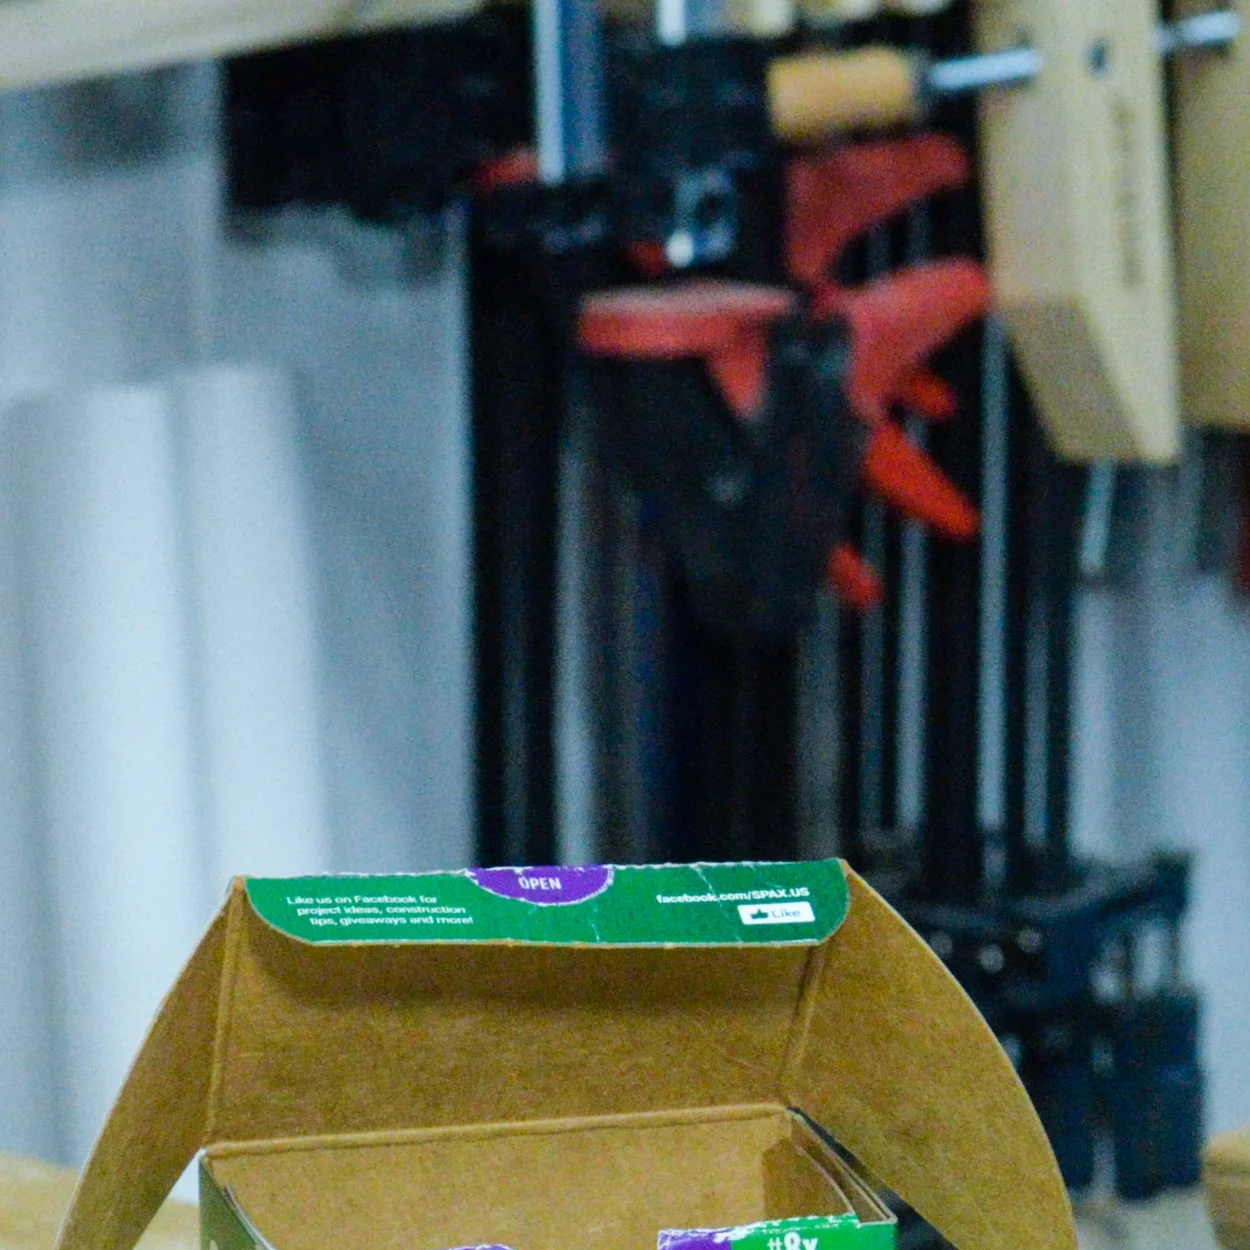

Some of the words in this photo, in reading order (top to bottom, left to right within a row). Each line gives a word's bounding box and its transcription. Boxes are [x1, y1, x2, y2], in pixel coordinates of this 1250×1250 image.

[518, 876, 562, 891] OPEN
[287, 896, 314, 905] Like
[318, 897, 332, 905] us
[354, 895, 417, 904] Facebook
[419, 895, 437, 904] for
[656, 888, 810, 904] facebook.com/SPAX.US
[297, 905, 341, 916] project
[344, 905, 383, 915] ideas,
[386, 905, 465, 915] construction
[772, 909, 801, 918] Like
[309, 916, 337, 926] tips,
[339, 916, 406, 926] giveaways
[409, 915, 433, 924] and
[436, 915, 473, 925] more!
